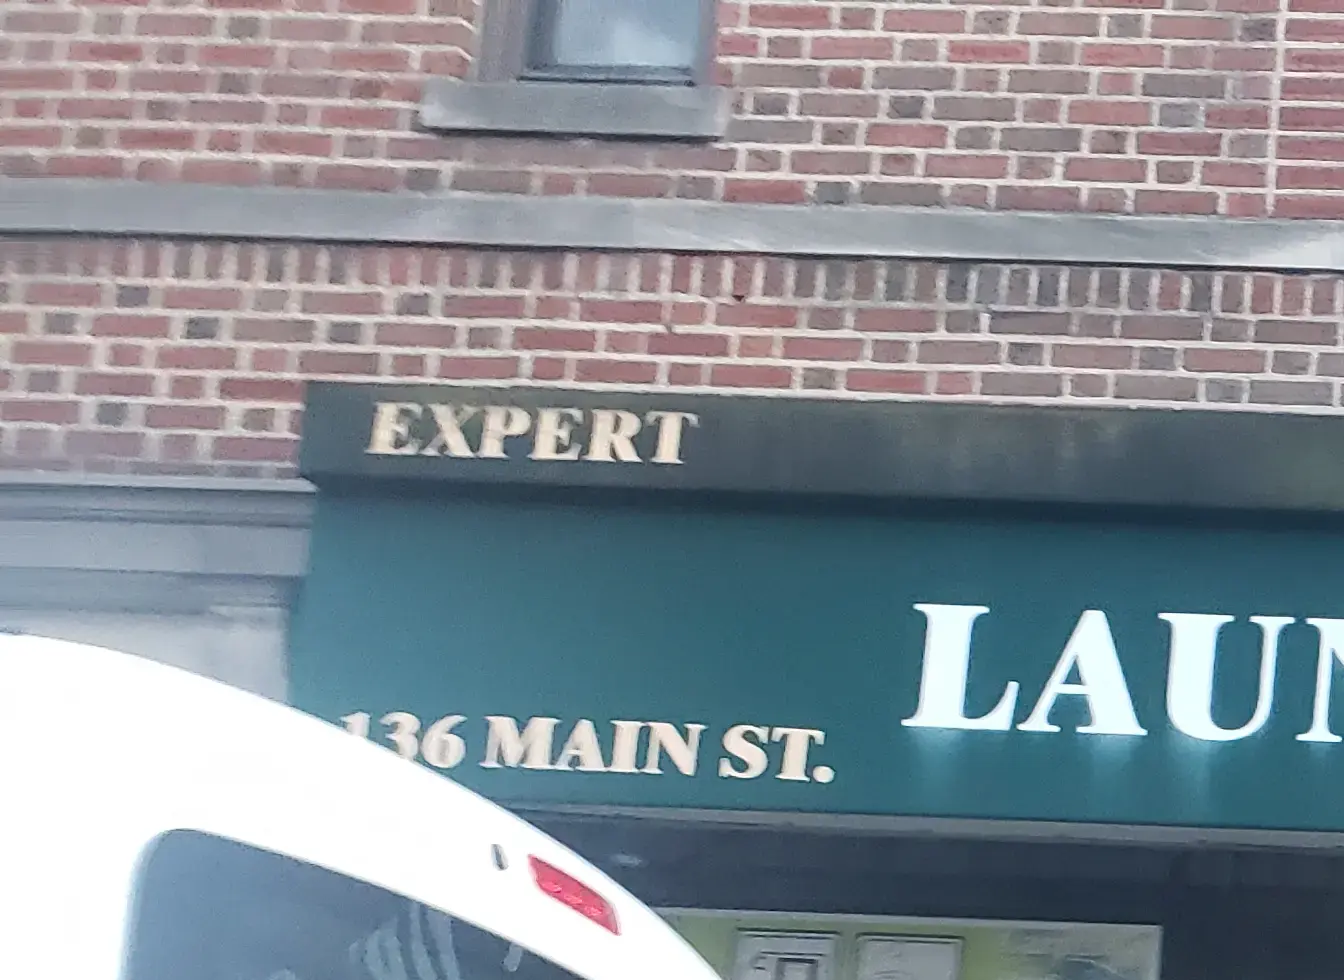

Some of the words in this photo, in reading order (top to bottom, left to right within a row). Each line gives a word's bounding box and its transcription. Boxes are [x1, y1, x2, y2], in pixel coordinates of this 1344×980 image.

[364, 401, 699, 465] EXPERT
[478, 714, 708, 777] MAIN
[718, 723, 836, 784] ST.
